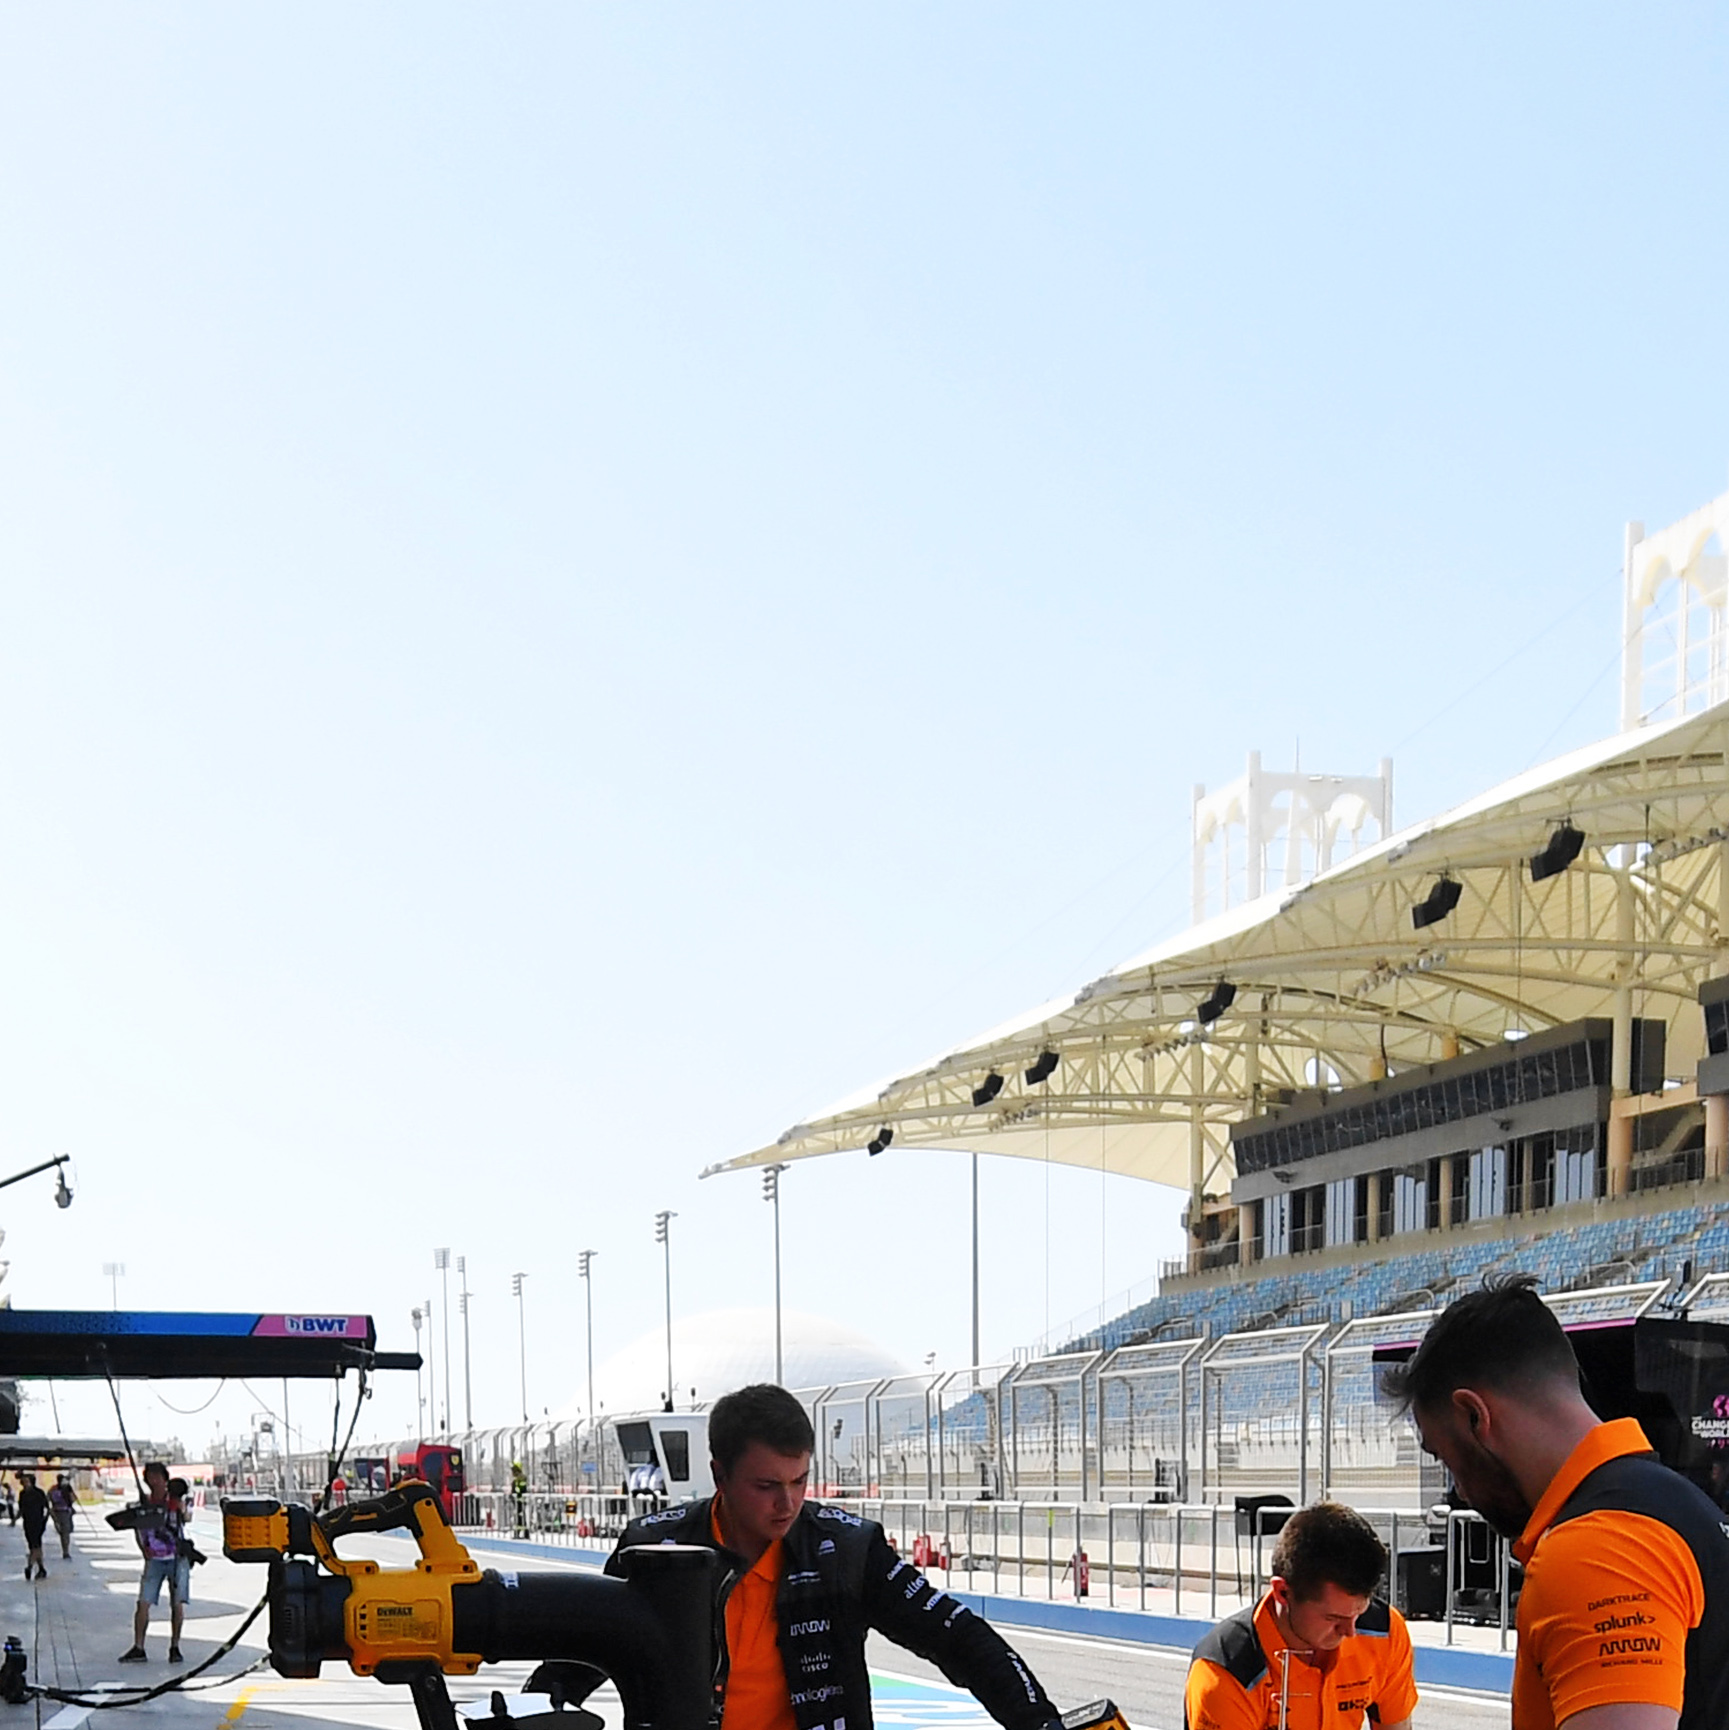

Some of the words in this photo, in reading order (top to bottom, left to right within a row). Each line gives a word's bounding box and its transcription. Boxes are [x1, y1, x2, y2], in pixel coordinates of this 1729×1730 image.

[303, 1318, 346, 1332] BWT
[1588, 1593, 1649, 1611] DARKTRACE
[1599, 1638, 1661, 1657] ARROW
